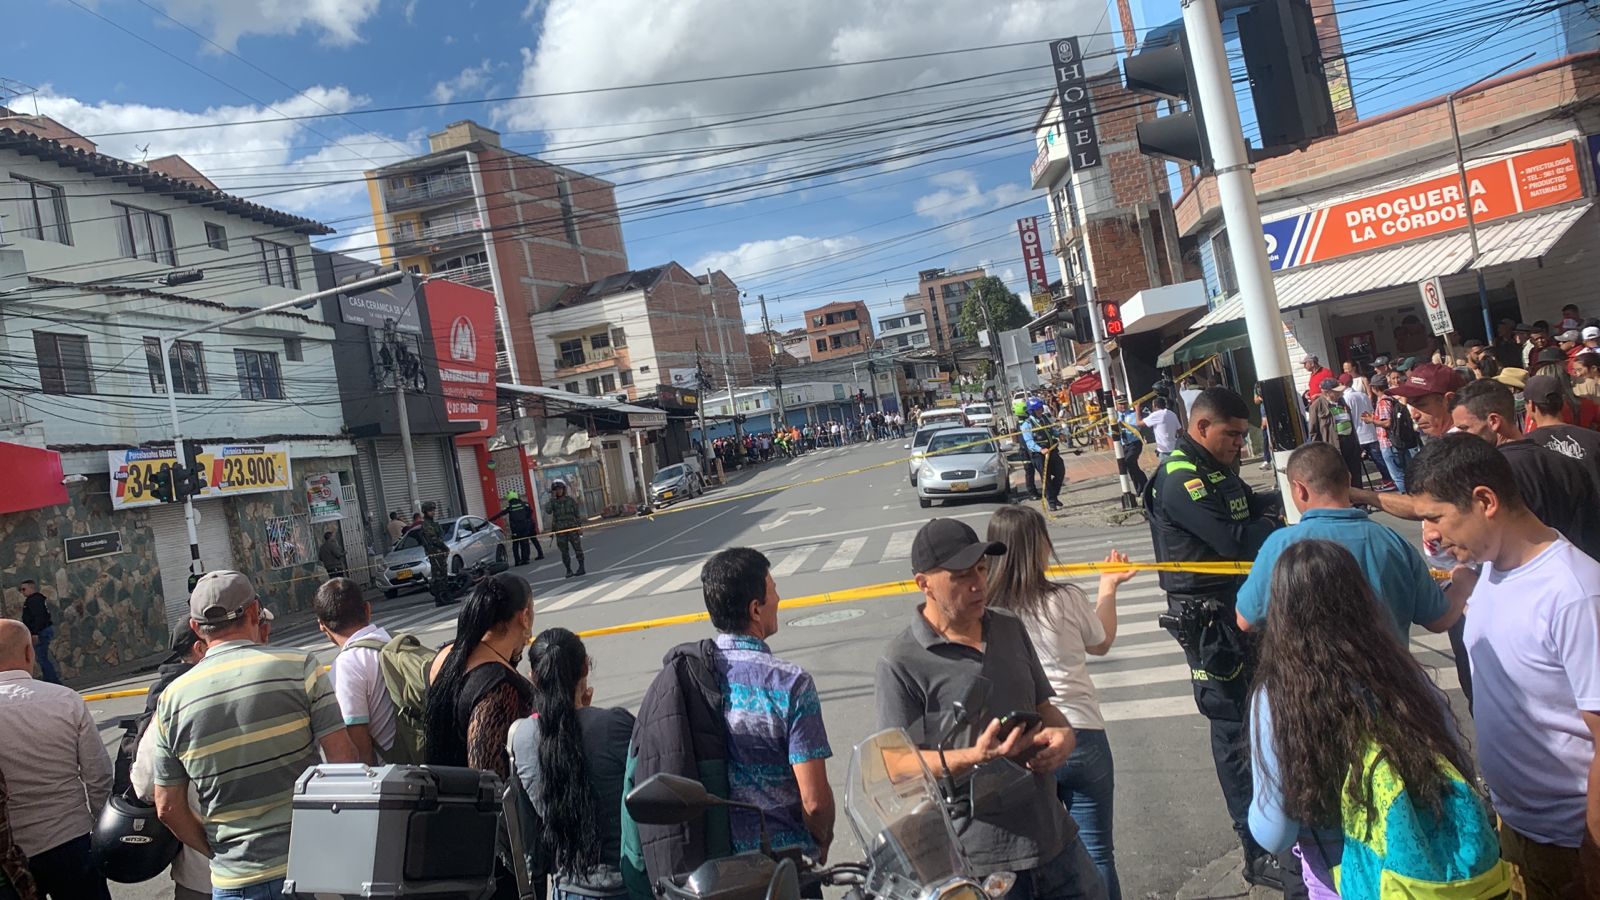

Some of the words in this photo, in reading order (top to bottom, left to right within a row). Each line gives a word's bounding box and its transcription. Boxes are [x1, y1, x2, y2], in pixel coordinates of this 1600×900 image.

[1058, 64, 1097, 168] HOTEL
[1528, 174, 1568, 190] PRODUCTOS
[1530, 183, 1569, 198] NATURALES
[1351, 226, 1377, 244] LA
[1020, 216, 1044, 285] HOTEL
[1107, 320, 1122, 334] 20
[224, 456, 276, 486] 23.900
